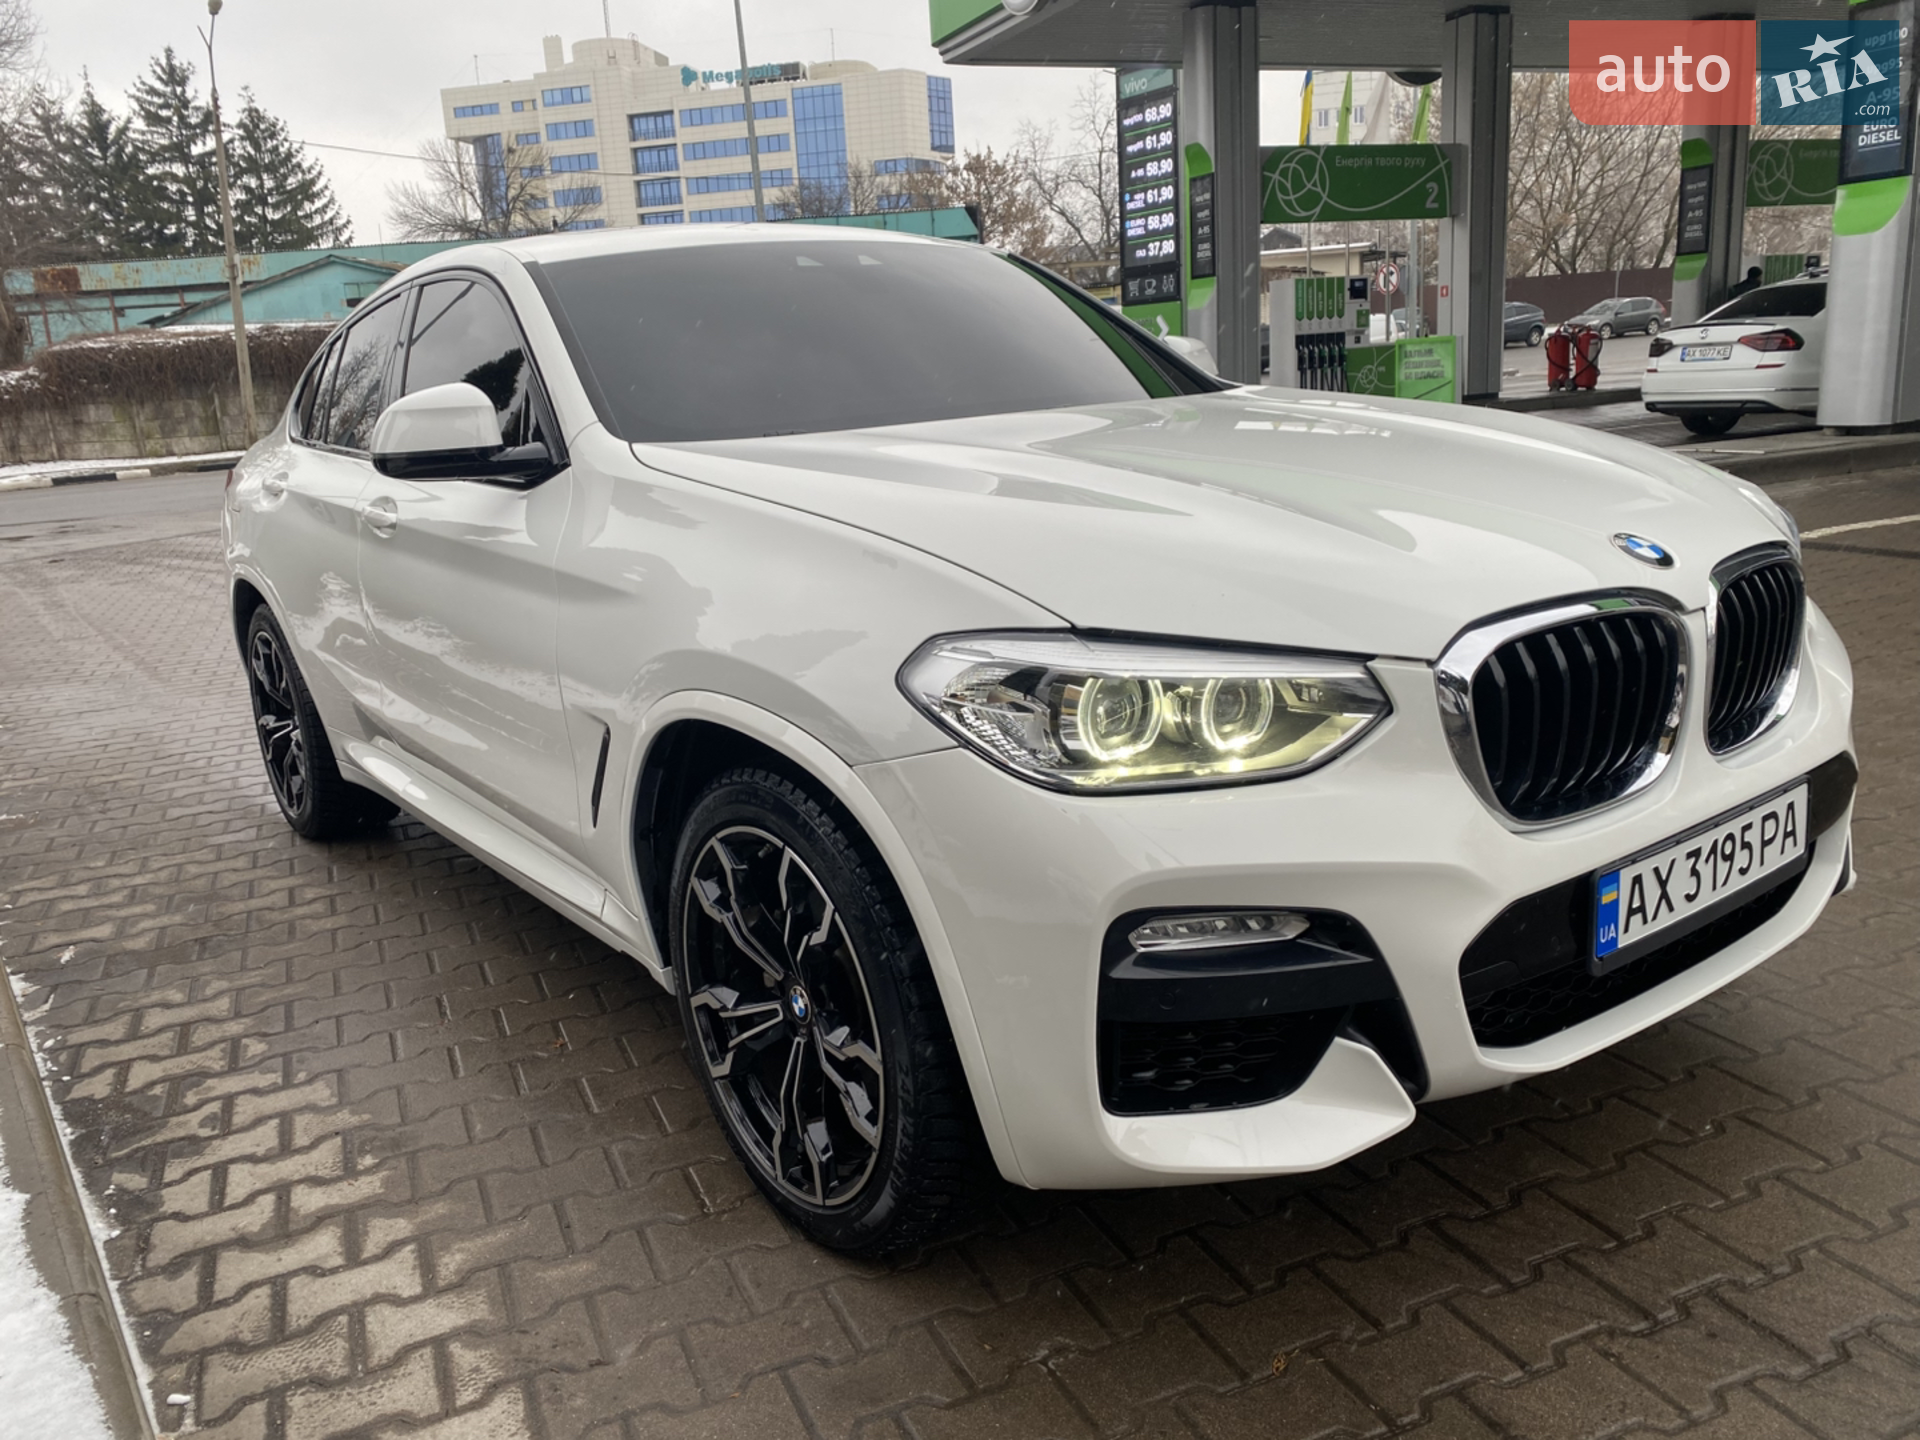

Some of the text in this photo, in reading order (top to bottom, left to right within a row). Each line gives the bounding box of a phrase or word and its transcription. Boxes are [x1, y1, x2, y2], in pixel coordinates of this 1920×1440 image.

[1124, 77, 1148, 94] vivo
[1145, 102, 1172, 122] 68,90
[1863, 116, 1898, 133] EURO
[1145, 130, 1173, 150] 61,90
[1858, 129, 1902, 147] DIESEL
[1146, 158, 1174, 177] 58,90
[1335, 155, 1427, 169] Енергія твого руху
[1147, 185, 1174, 204] 61,90
[1425, 181, 1439, 209] 2
[1147, 212, 1175, 231] 58,90
[1623, 800, 1798, 935] AX 3195 PA
[1599, 922, 1617, 944] UA
